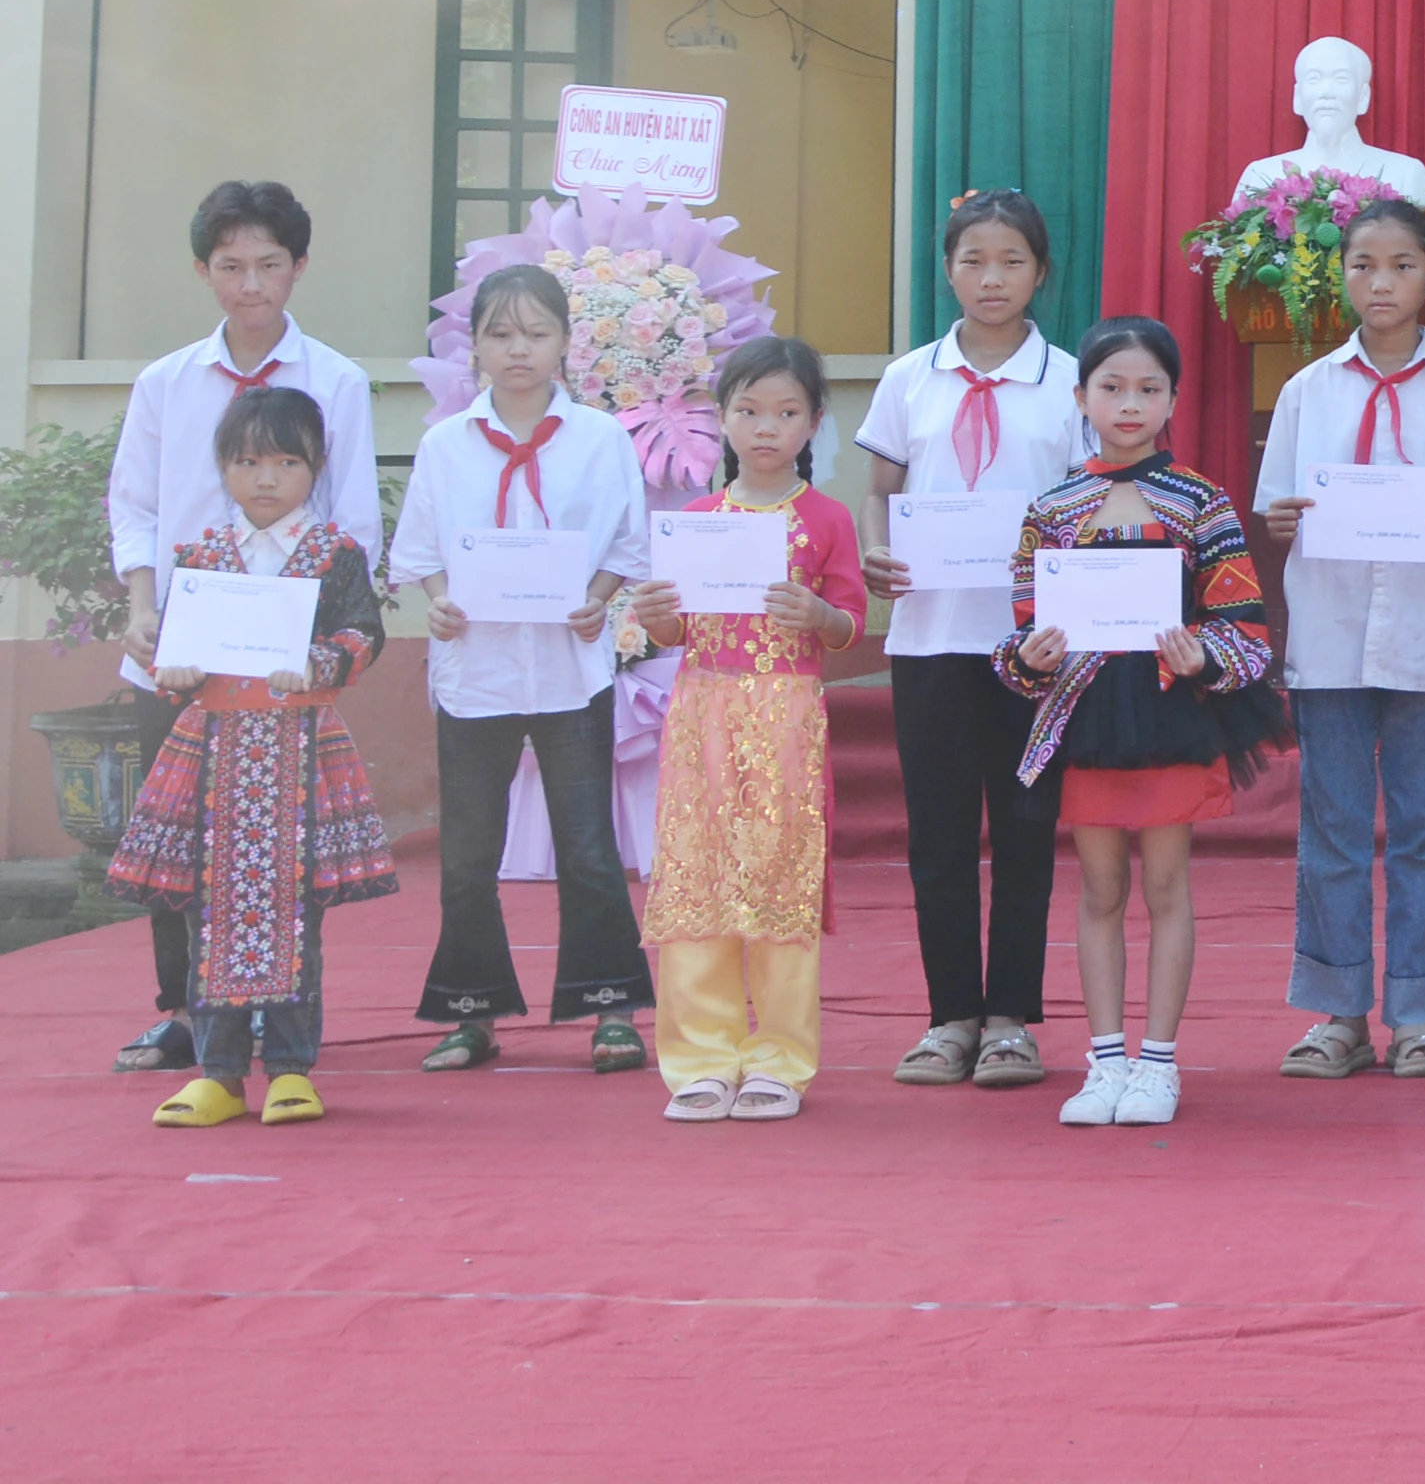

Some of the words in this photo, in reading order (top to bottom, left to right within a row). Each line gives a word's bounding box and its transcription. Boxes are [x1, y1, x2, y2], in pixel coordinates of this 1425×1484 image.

[570, 103, 602, 134] CÔNG
[604, 111, 621, 136] AN
[623, 109, 662, 144] HUYỆN
[665, 111, 687, 141] BÁT
[689, 113, 712, 143] XÁT
[566, 148, 624, 172] Chúc
[634, 155, 708, 188] Mừng
